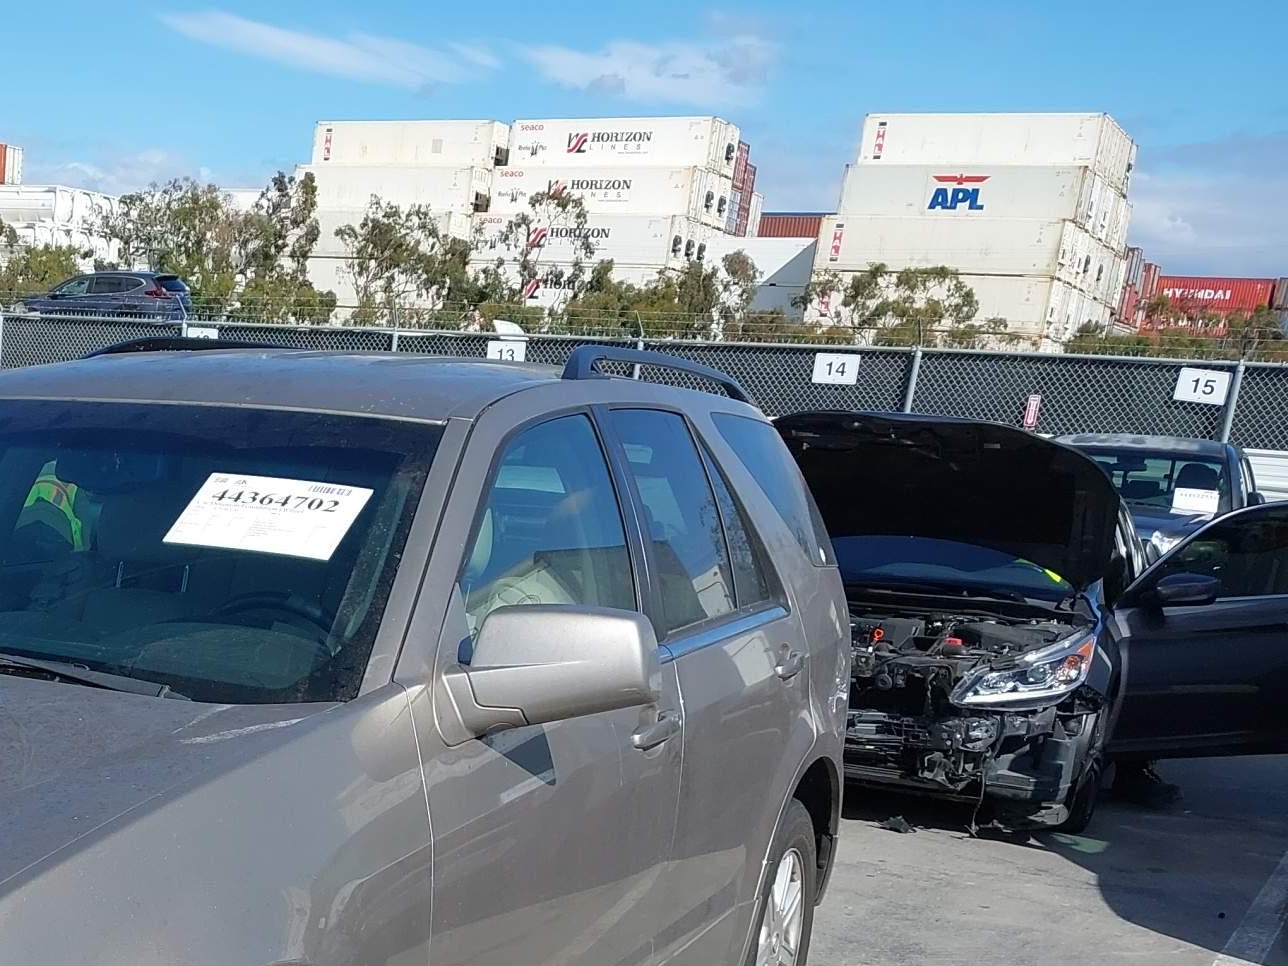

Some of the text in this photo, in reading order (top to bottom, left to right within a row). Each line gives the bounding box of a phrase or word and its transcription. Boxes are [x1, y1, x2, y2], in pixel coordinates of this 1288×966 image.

[591, 131, 653, 142] HORIZON
[589, 143, 641, 151] LINES
[570, 179, 632, 190] HORIZON
[927, 187, 985, 211] APL
[549, 227, 610, 239] HORIZON
[497, 348, 515, 360] 13
[825, 361, 847, 377] 14
[1191, 377, 1217, 396] 15
[211, 488, 340, 513] 44364702
